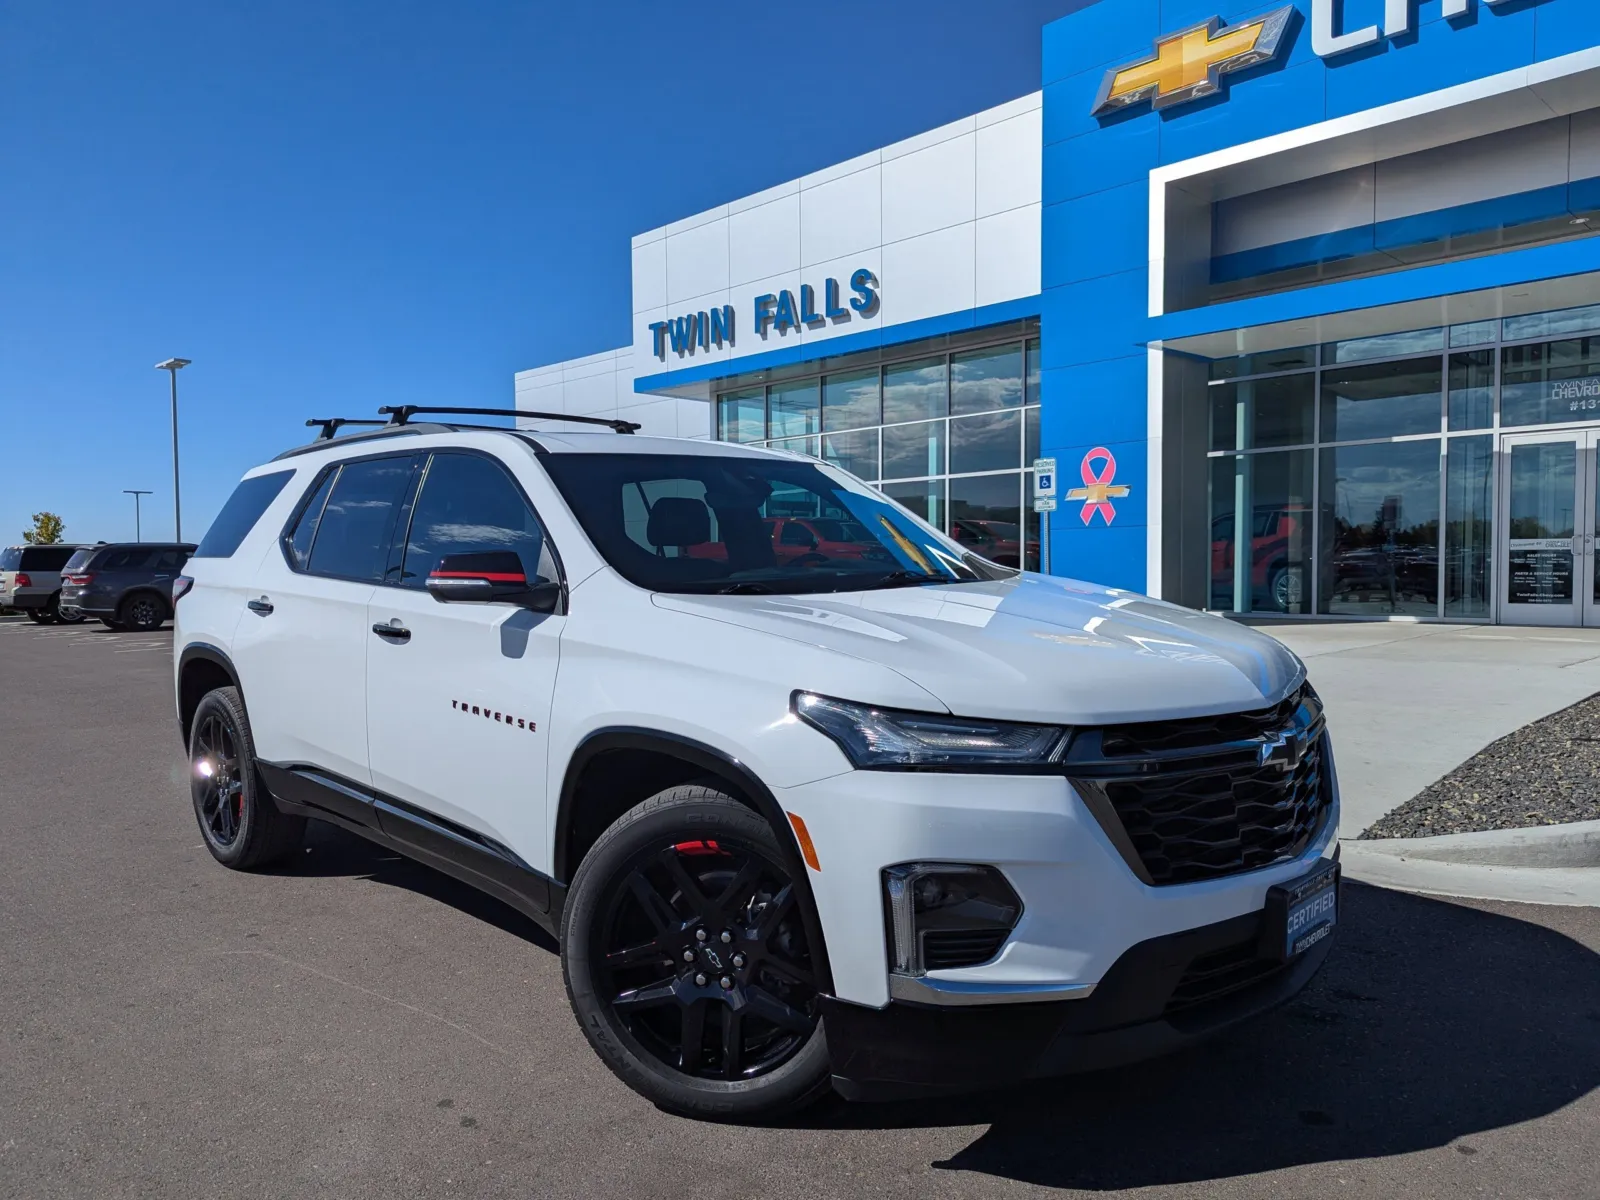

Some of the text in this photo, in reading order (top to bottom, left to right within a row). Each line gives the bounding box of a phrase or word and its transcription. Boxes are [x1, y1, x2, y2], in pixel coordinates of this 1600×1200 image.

[648, 268, 880, 360] TWIN FALLS
[451, 699, 537, 733] TRAVERSE
[1287, 891, 1336, 934] CERTIFIED
